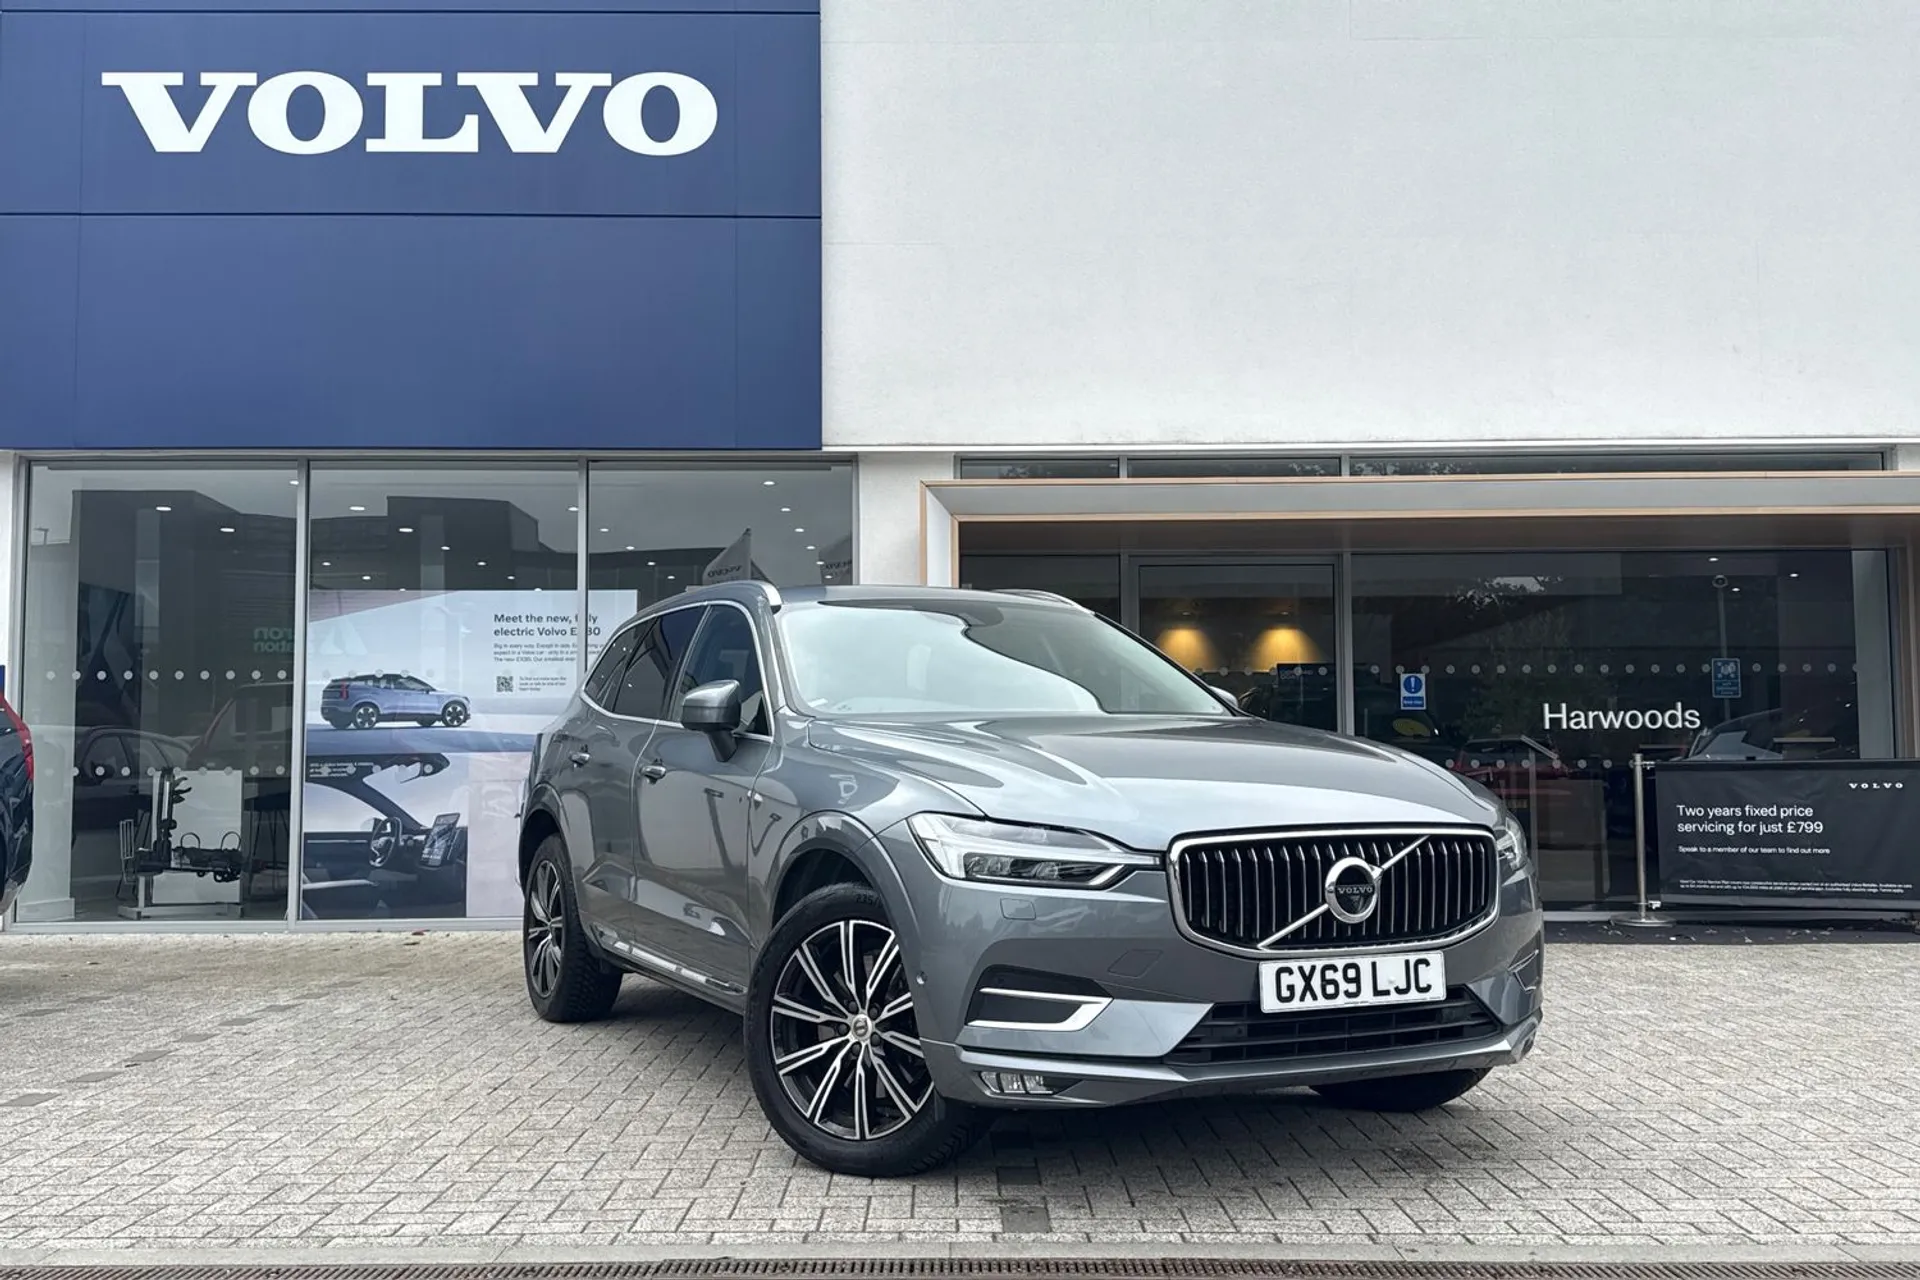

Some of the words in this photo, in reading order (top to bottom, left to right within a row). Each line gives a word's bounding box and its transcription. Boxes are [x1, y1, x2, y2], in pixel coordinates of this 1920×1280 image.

[101, 70, 719, 156] VOLVO
[493, 614, 522, 623] Meet
[525, 614, 543, 623] the
[546, 615, 572, 624] new,
[574, 614, 598, 624] fly
[493, 627, 535, 636] electric
[537, 627, 567, 636] Volvo
[570, 627, 601, 636] E30
[1543, 702, 1701, 730] Harwoods
[1677, 804, 1705, 817] Two
[1707, 807, 1742, 819] years
[1744, 804, 1777, 817] fixed
[1780, 805, 1814, 819] price
[1677, 821, 1735, 836] servicing
[1738, 821, 1756, 833] for
[1759, 821, 1783, 835] just
[1786, 821, 1823, 834] £799
[1786, 846, 1799, 854] find
[1338, 886, 1373, 894] VOLVO
[1275, 963, 1361, 1003] GX69
[1371, 958, 1432, 997] LJC
